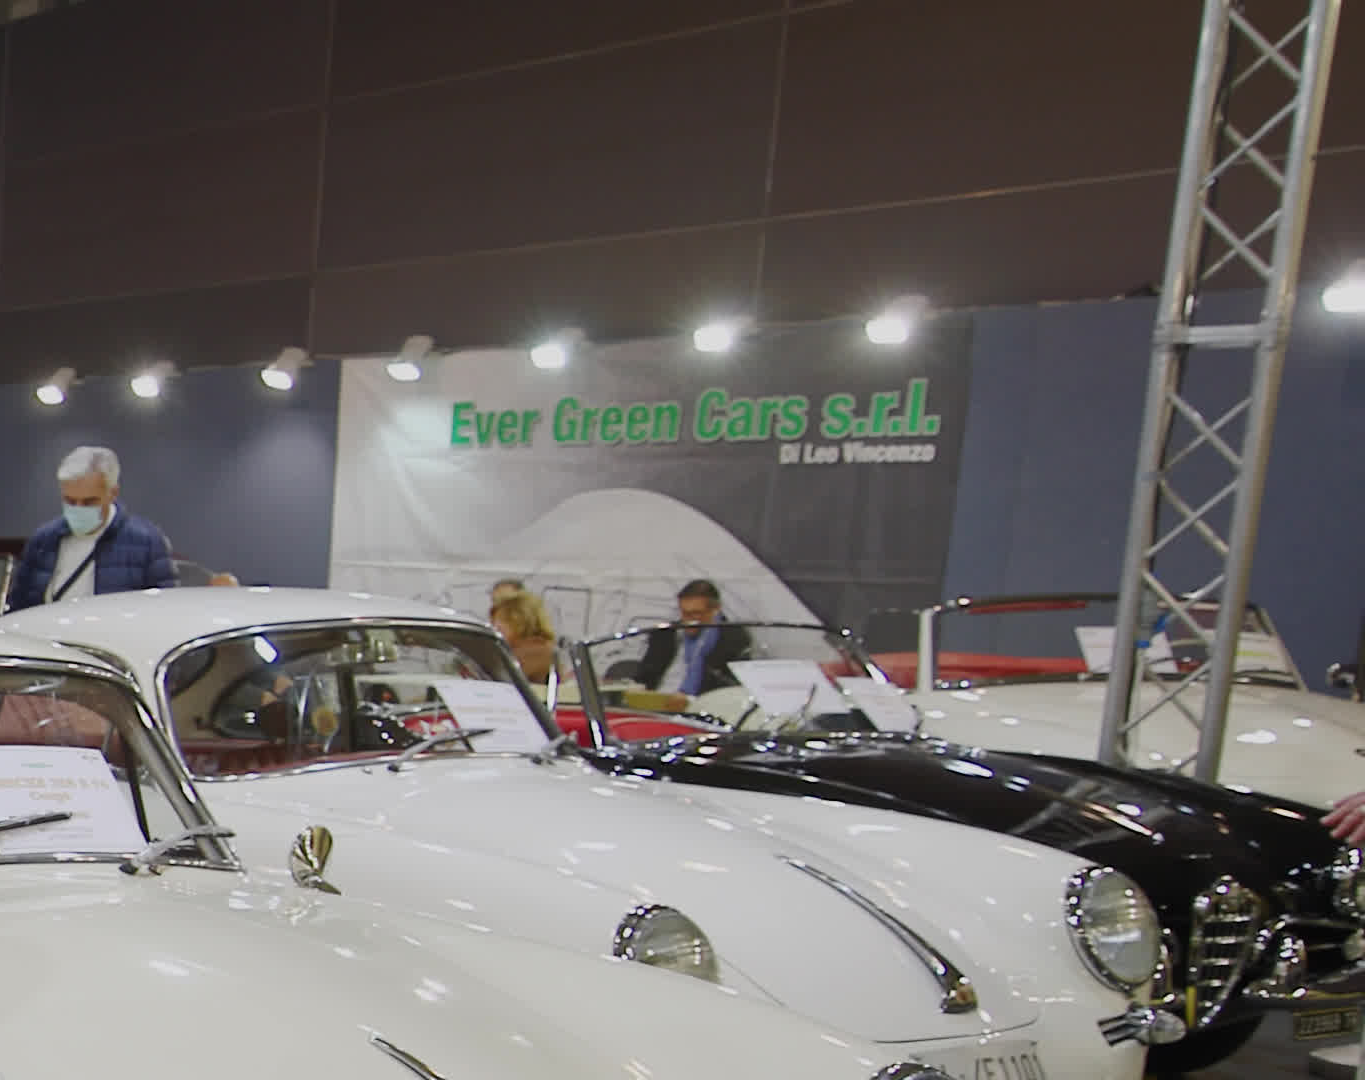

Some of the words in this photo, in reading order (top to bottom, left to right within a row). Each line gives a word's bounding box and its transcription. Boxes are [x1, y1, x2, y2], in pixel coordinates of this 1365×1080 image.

[449, 402, 539, 446] Ever
[552, 397, 679, 446] Green
[693, 389, 807, 441] Cars
[821, 378, 942, 438] s.r.l.
